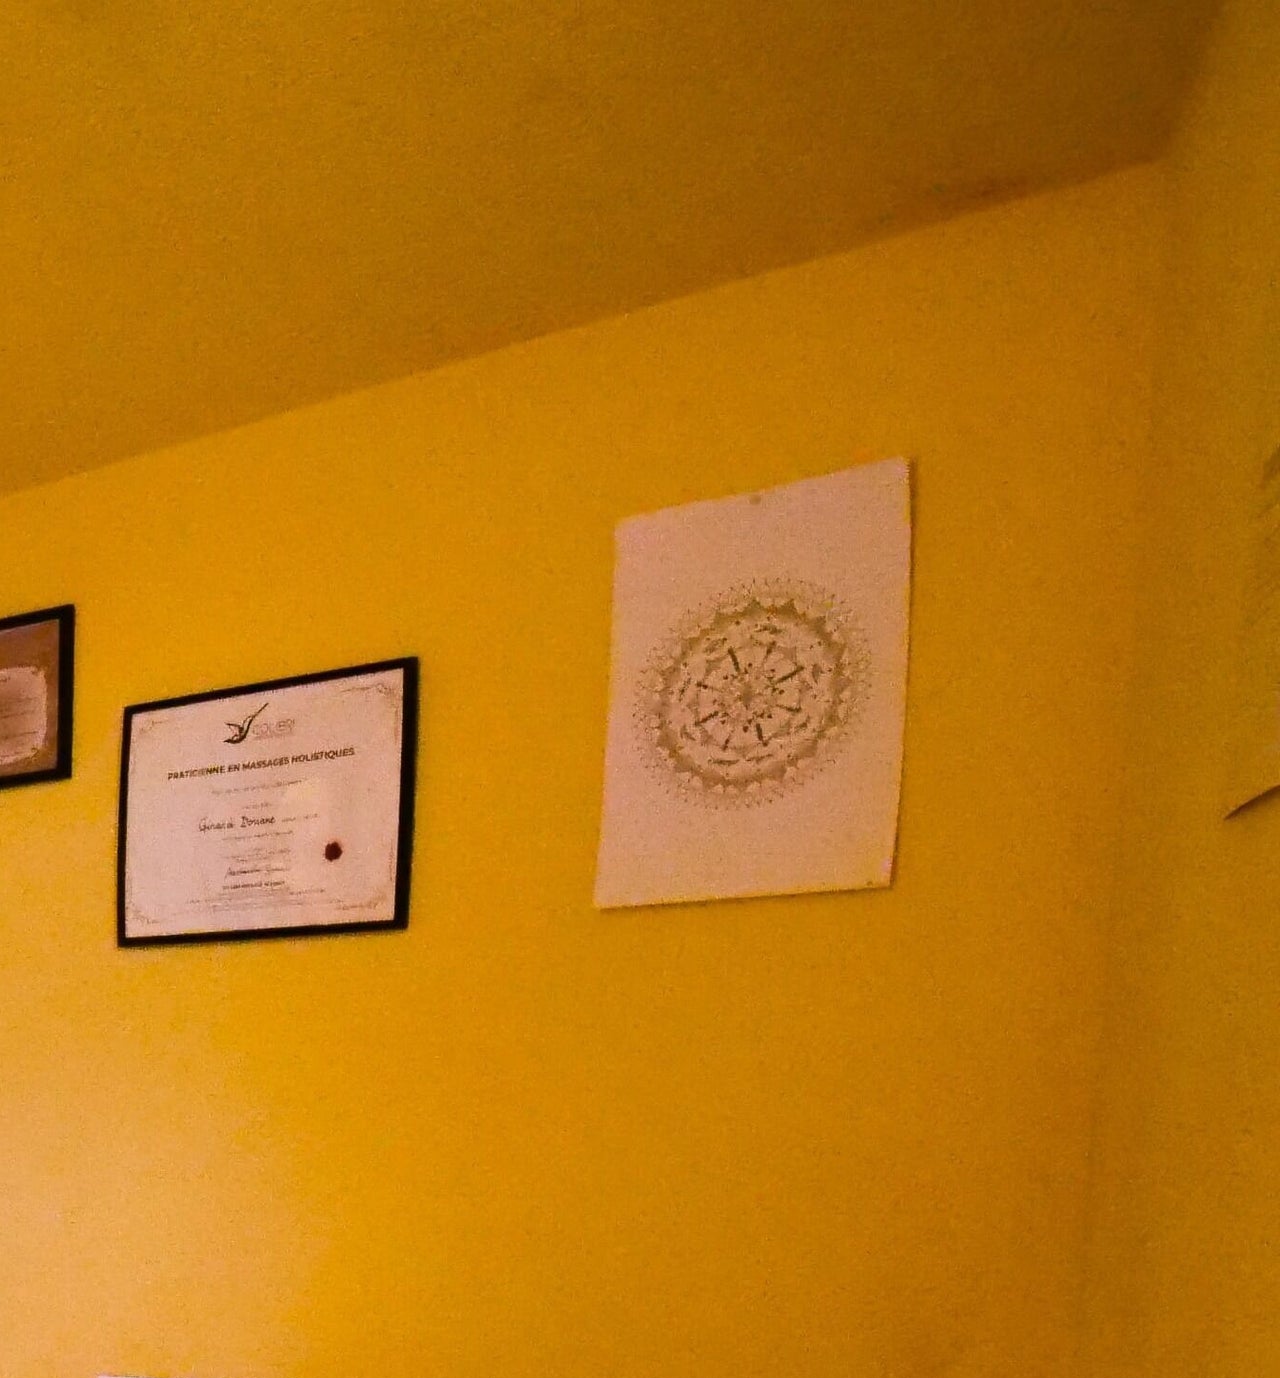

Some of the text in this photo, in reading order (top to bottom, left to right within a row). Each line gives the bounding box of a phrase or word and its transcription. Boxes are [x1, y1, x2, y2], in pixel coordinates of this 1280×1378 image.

[167, 747, 355, 780] PRATICIENNE EN MASSAGES HOLISTIQUES
